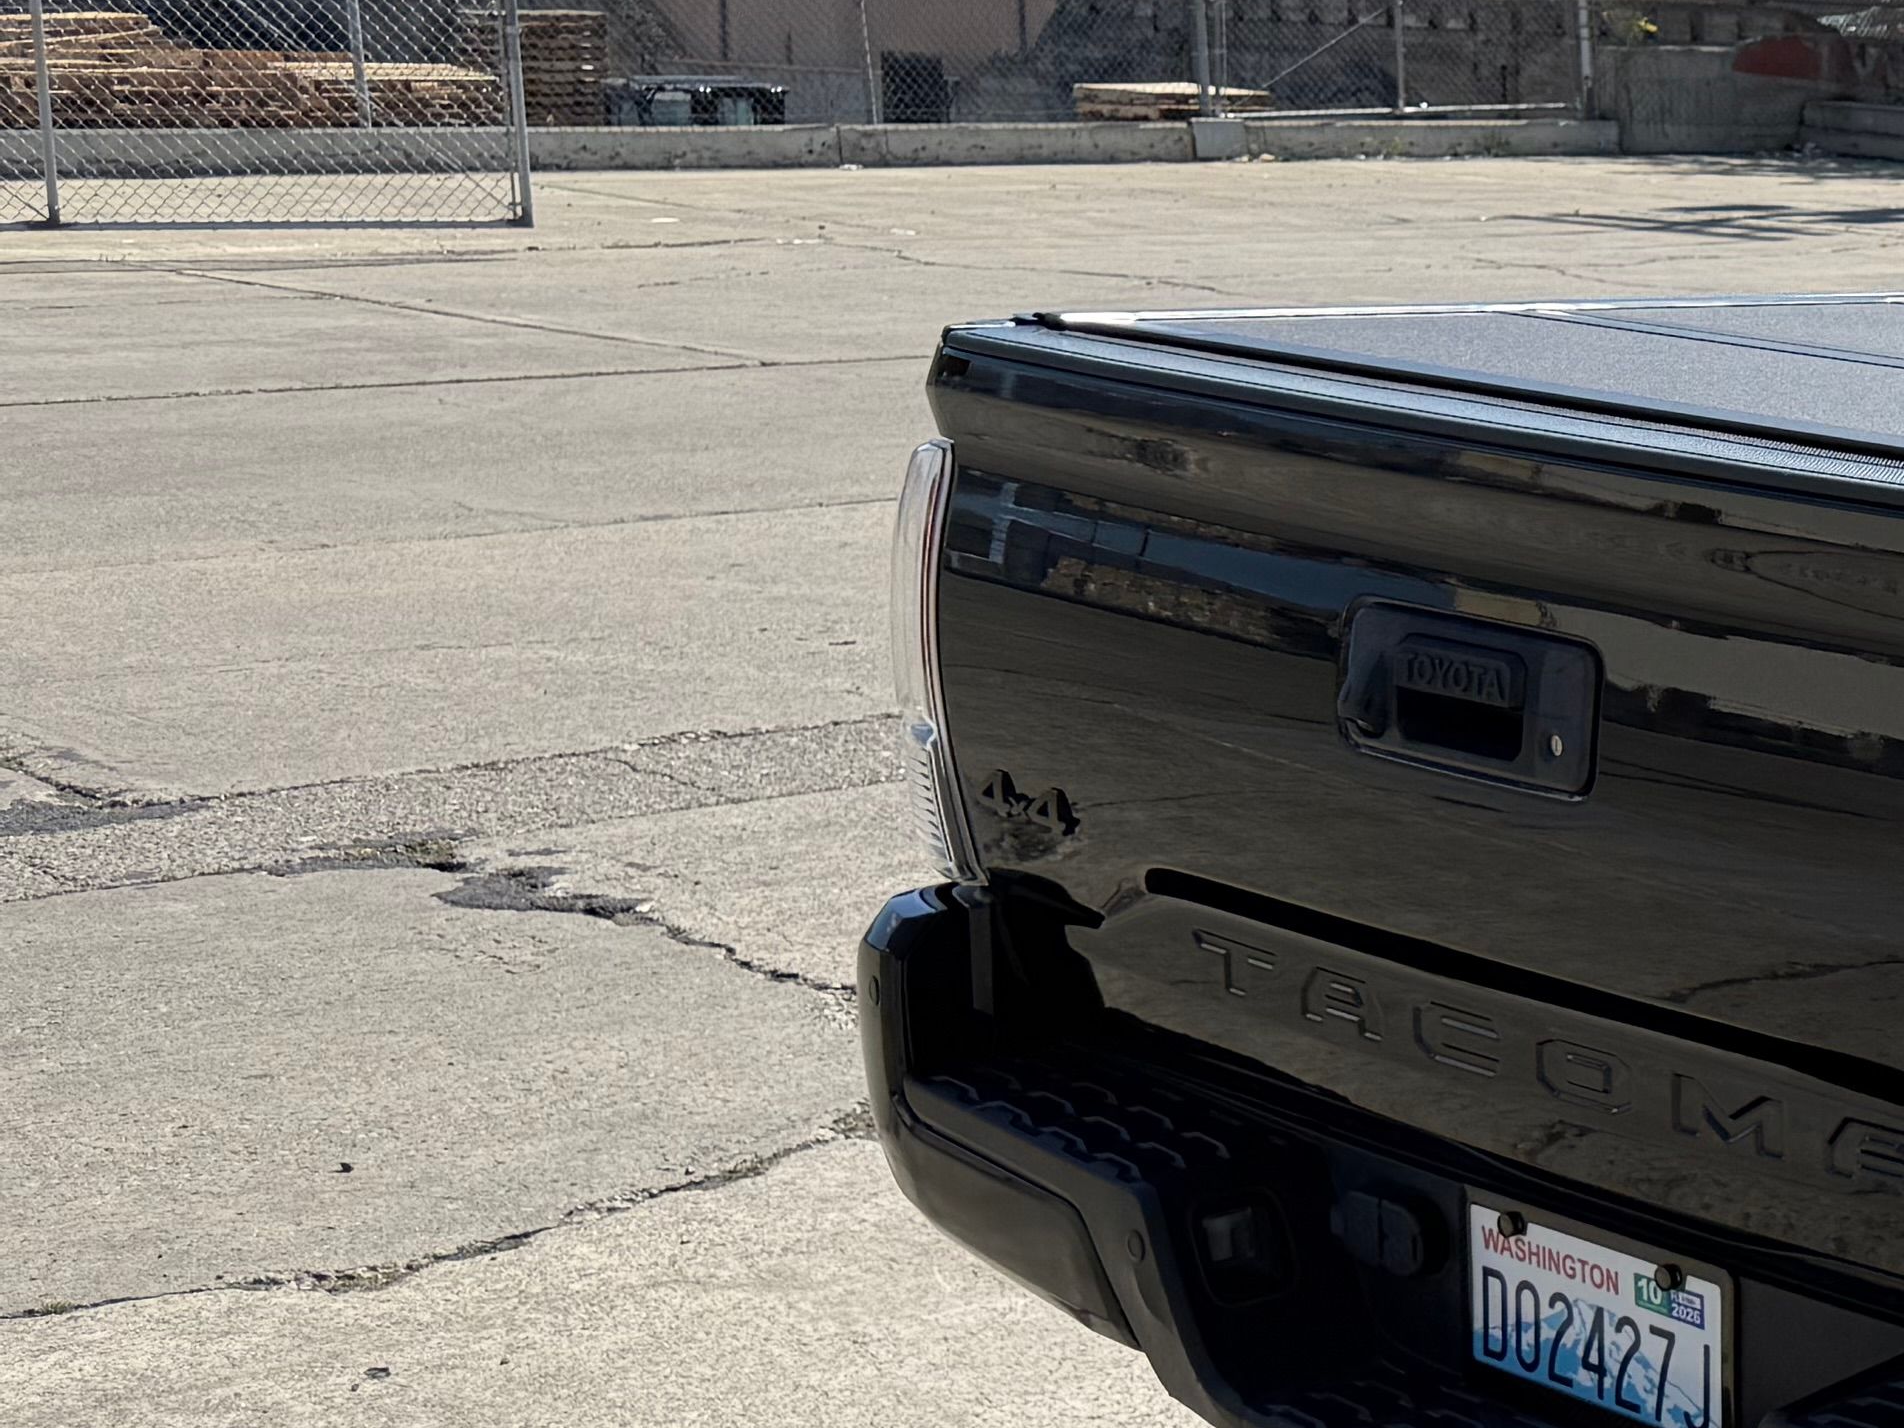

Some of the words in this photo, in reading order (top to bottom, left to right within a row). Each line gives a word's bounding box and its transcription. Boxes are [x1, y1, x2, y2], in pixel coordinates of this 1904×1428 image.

[1400, 652, 1506, 703] TOYOTA
[1481, 1225, 1620, 1296] WASHINGTON
[1636, 1276, 1664, 1305] 10
[1671, 1304, 1702, 1324] 2026
